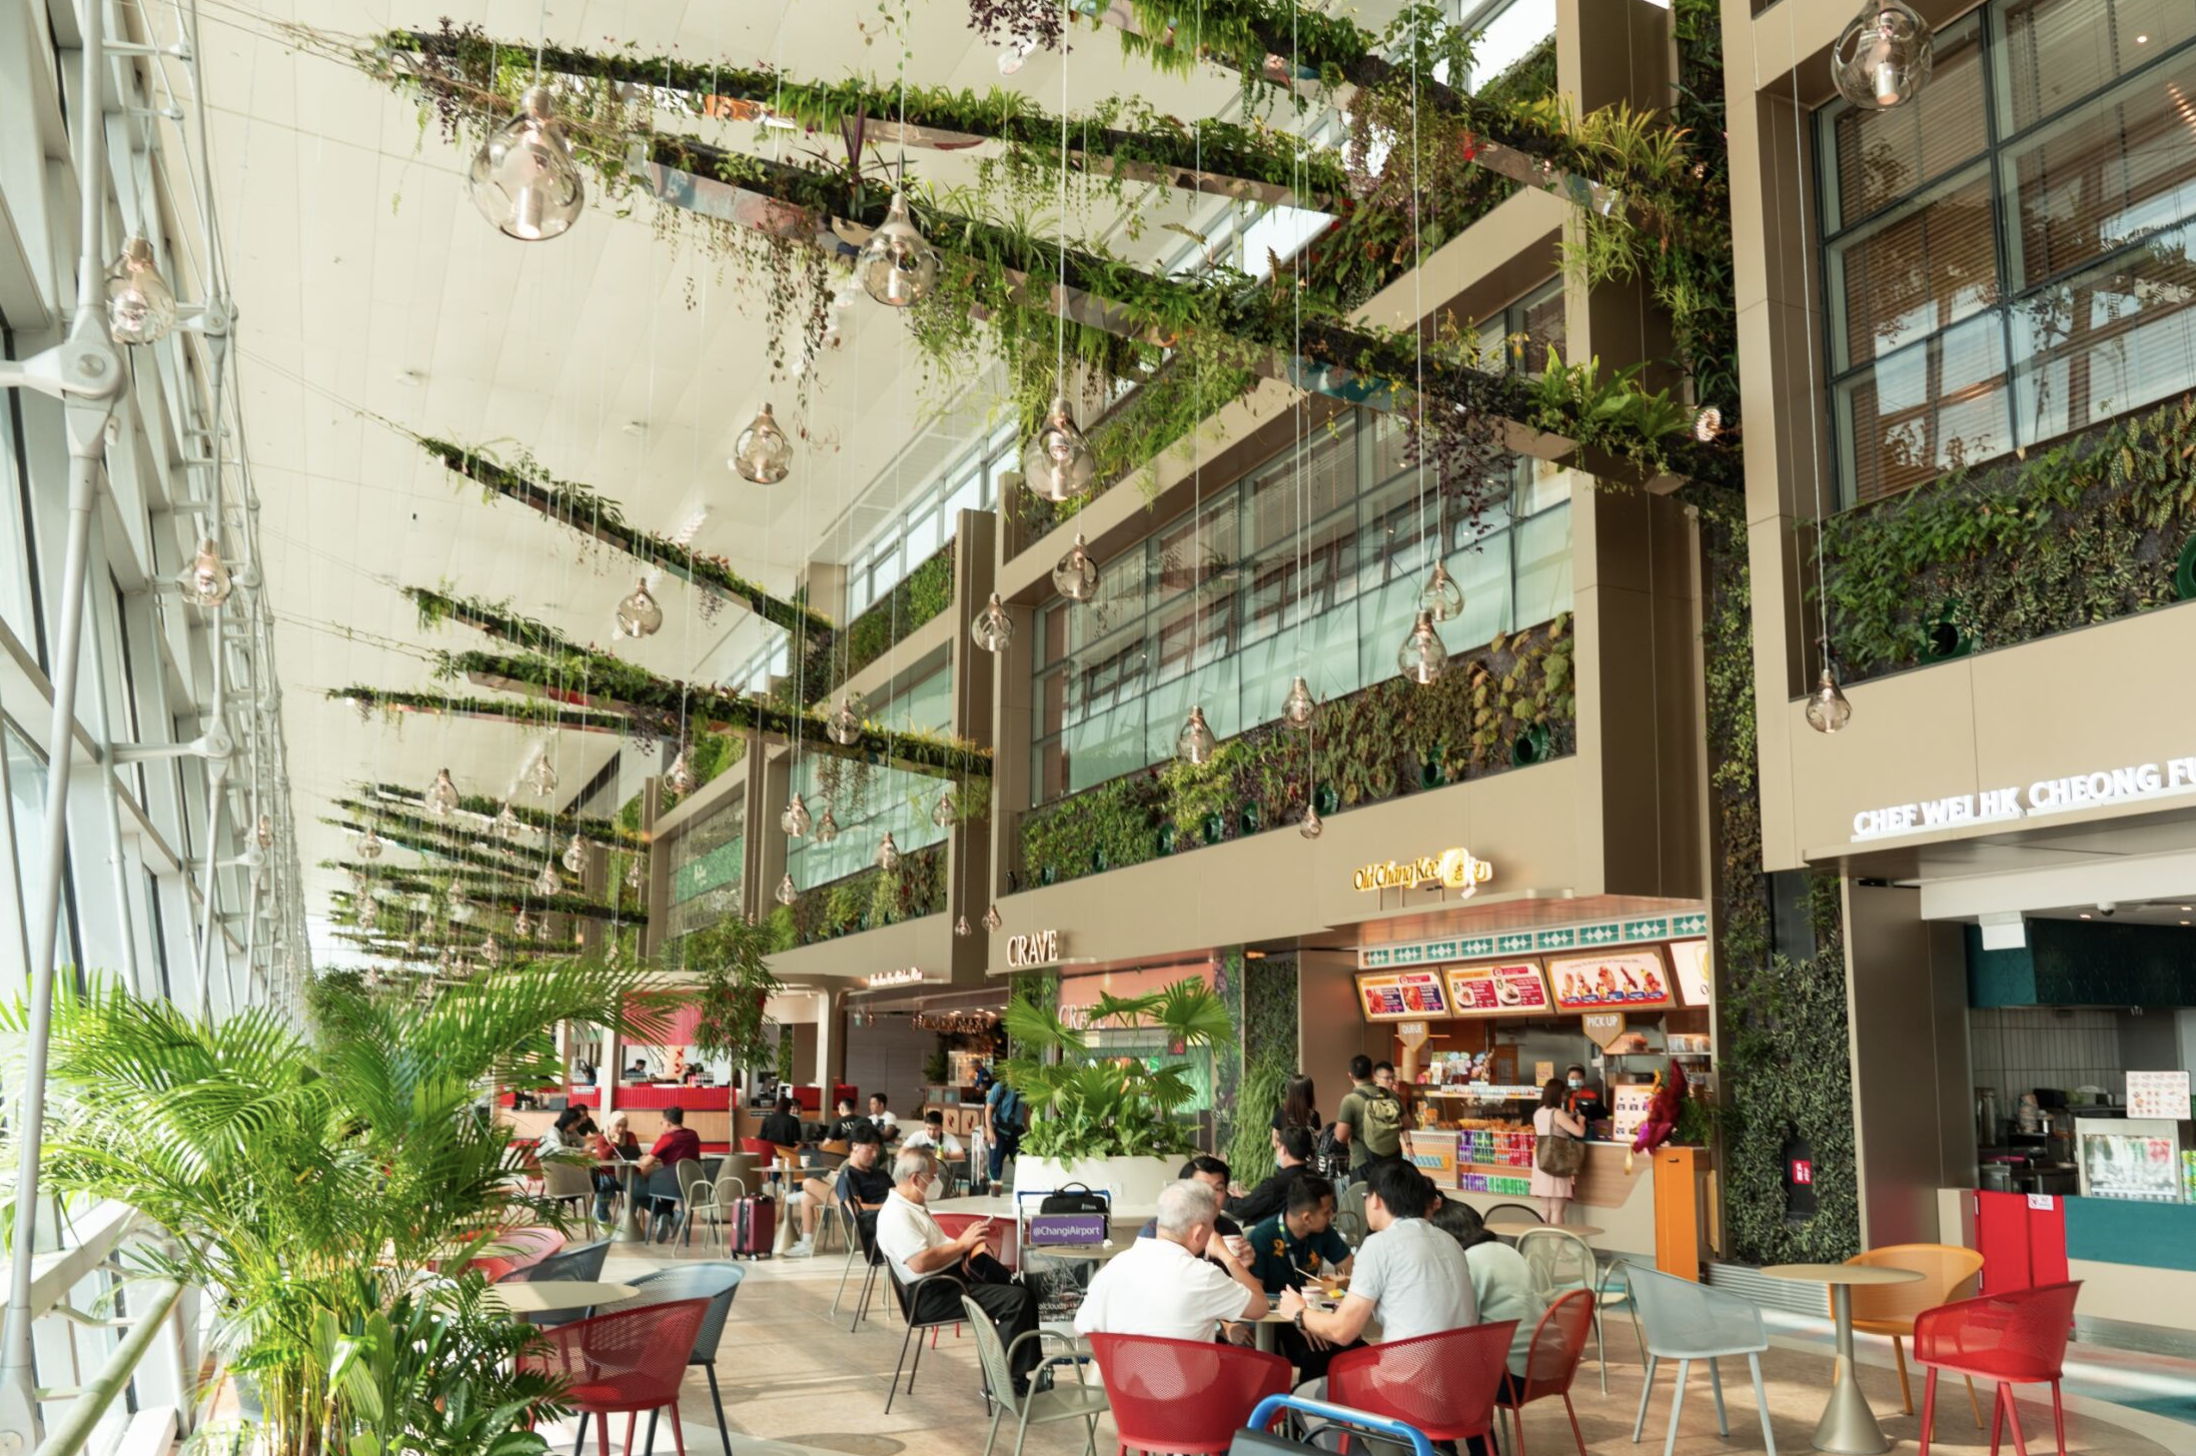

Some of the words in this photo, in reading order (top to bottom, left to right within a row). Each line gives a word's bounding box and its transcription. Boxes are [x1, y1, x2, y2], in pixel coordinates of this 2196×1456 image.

[1853, 803, 1918, 836] CHEF
[1920, 794, 1974, 825] WEI
[1979, 786, 2025, 818] HK
[2028, 763, 2162, 808] CHEONG
[1353, 863, 1374, 891] Old
[1375, 860, 1415, 889] Chang
[1415, 857, 1442, 881] Kee
[1006, 930, 1058, 967] CRAVE
[1401, 1023, 1423, 1035] QUEUE
[1586, 1015, 1605, 1027] PICK
[1606, 1015, 1618, 1026] UP
[1033, 1224, 1101, 1238] @ChangiAirport
